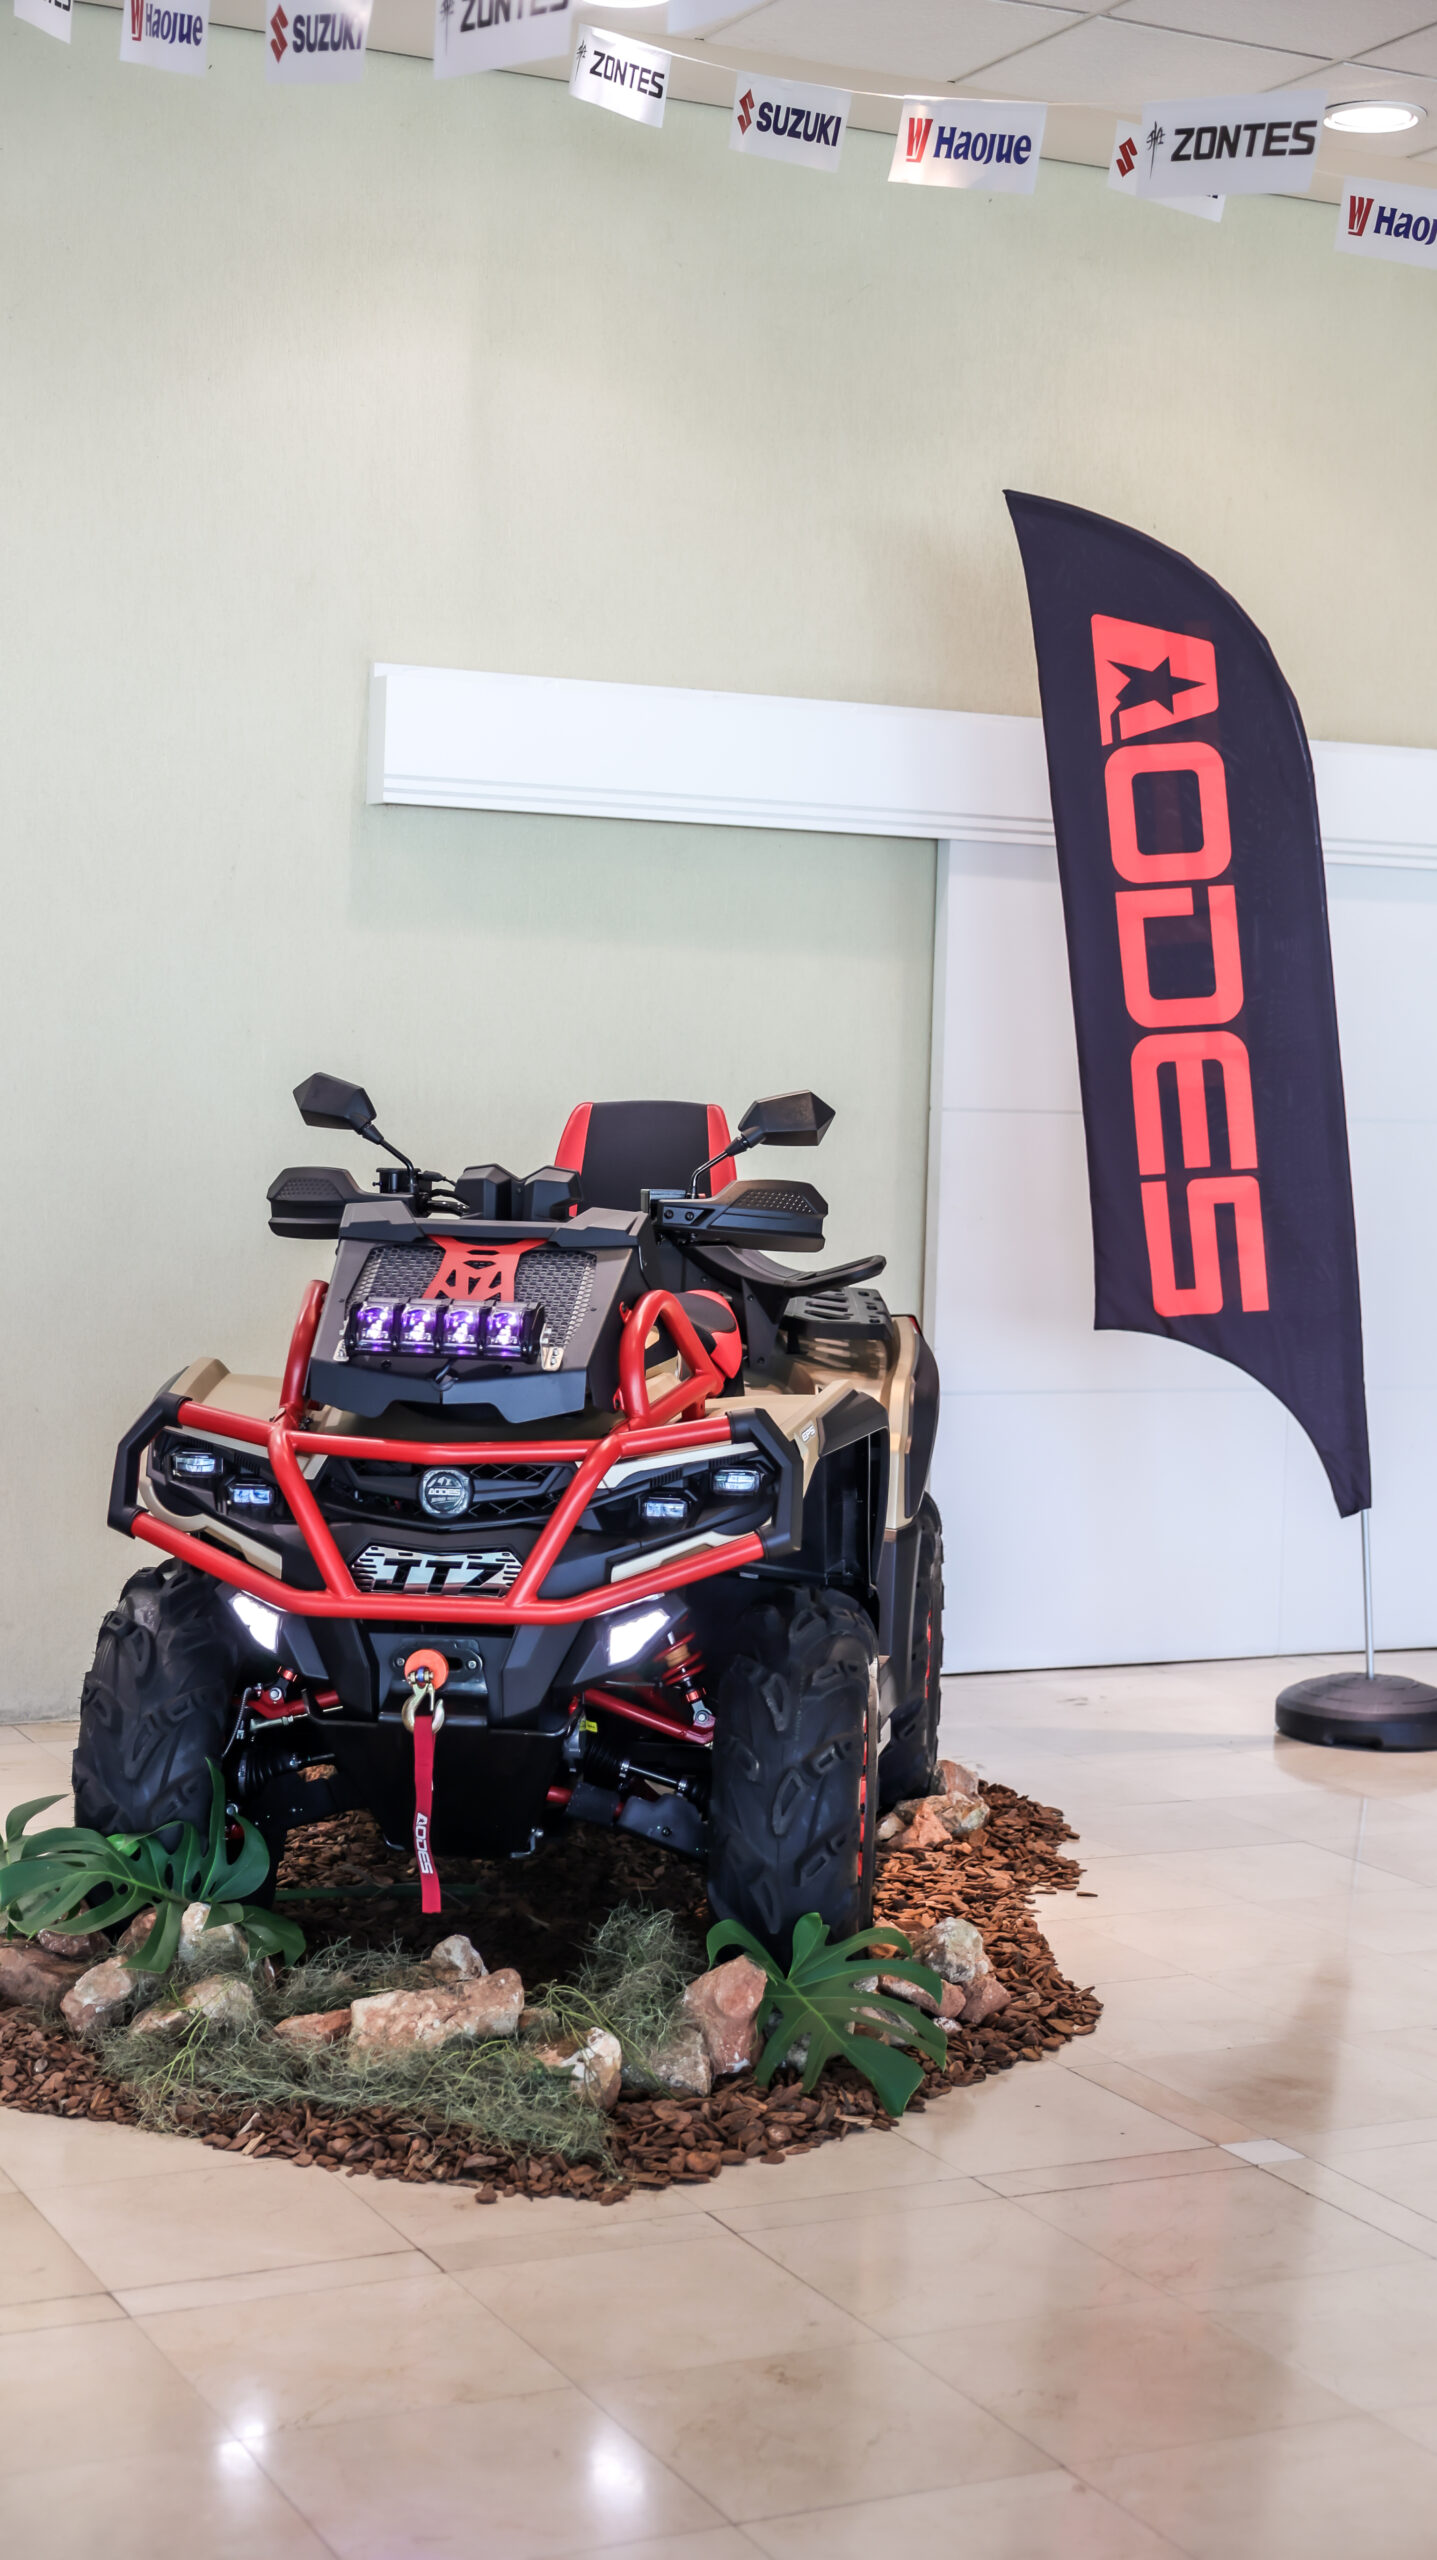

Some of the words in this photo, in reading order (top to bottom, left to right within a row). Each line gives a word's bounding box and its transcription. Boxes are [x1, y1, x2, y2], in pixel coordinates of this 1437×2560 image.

[292, 14, 362, 53] SUZUKI
[589, 50, 665, 99] ZONTES
[756, 101, 842, 147] SUZUKI
[1171, 120, 1318, 162] ZONTES
[1090, 613, 1270, 1318] AODES
[415, 1812, 433, 1875] AODES
